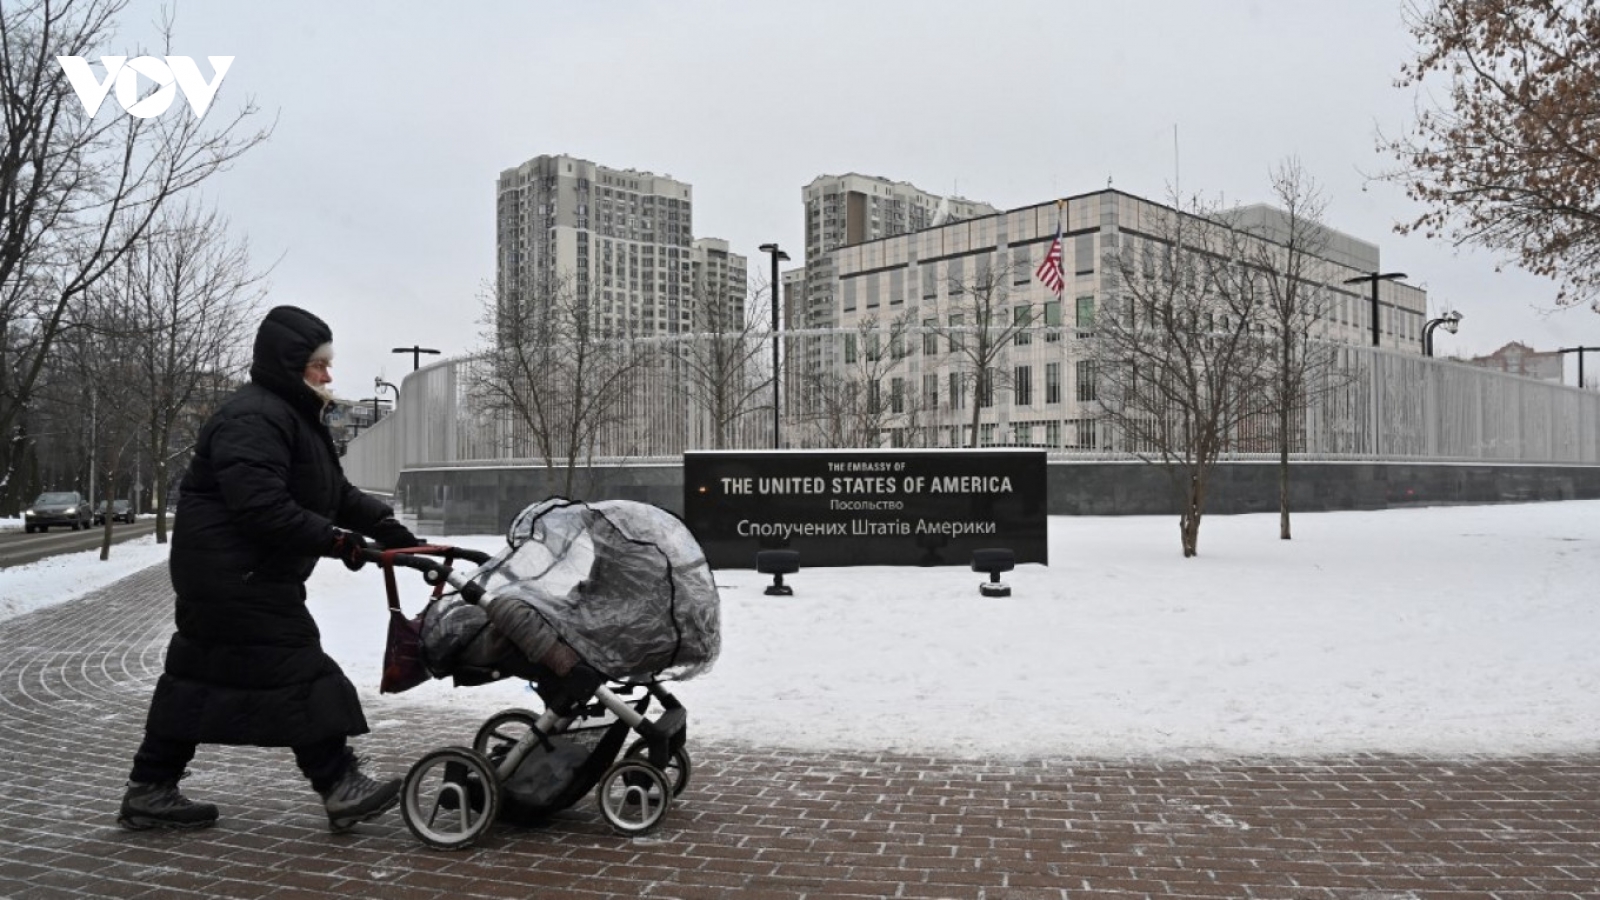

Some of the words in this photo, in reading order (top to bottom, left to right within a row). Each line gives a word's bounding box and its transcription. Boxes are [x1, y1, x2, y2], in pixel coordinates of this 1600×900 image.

[828, 462, 845, 472] THE
[847, 462, 891, 472] EMBASSY
[893, 462, 906, 472] OF
[721, 477, 753, 495] THE
[758, 477, 826, 494] UNITED
[832, 476, 897, 494] STATES
[903, 476, 925, 493] OF
[930, 475, 1013, 493] AMERICA
[830, 499, 904, 511] Посольство
[736, 519, 848, 540] Сполучених
[852, 518, 911, 535] Штатів
[915, 518, 996, 538] Америки
